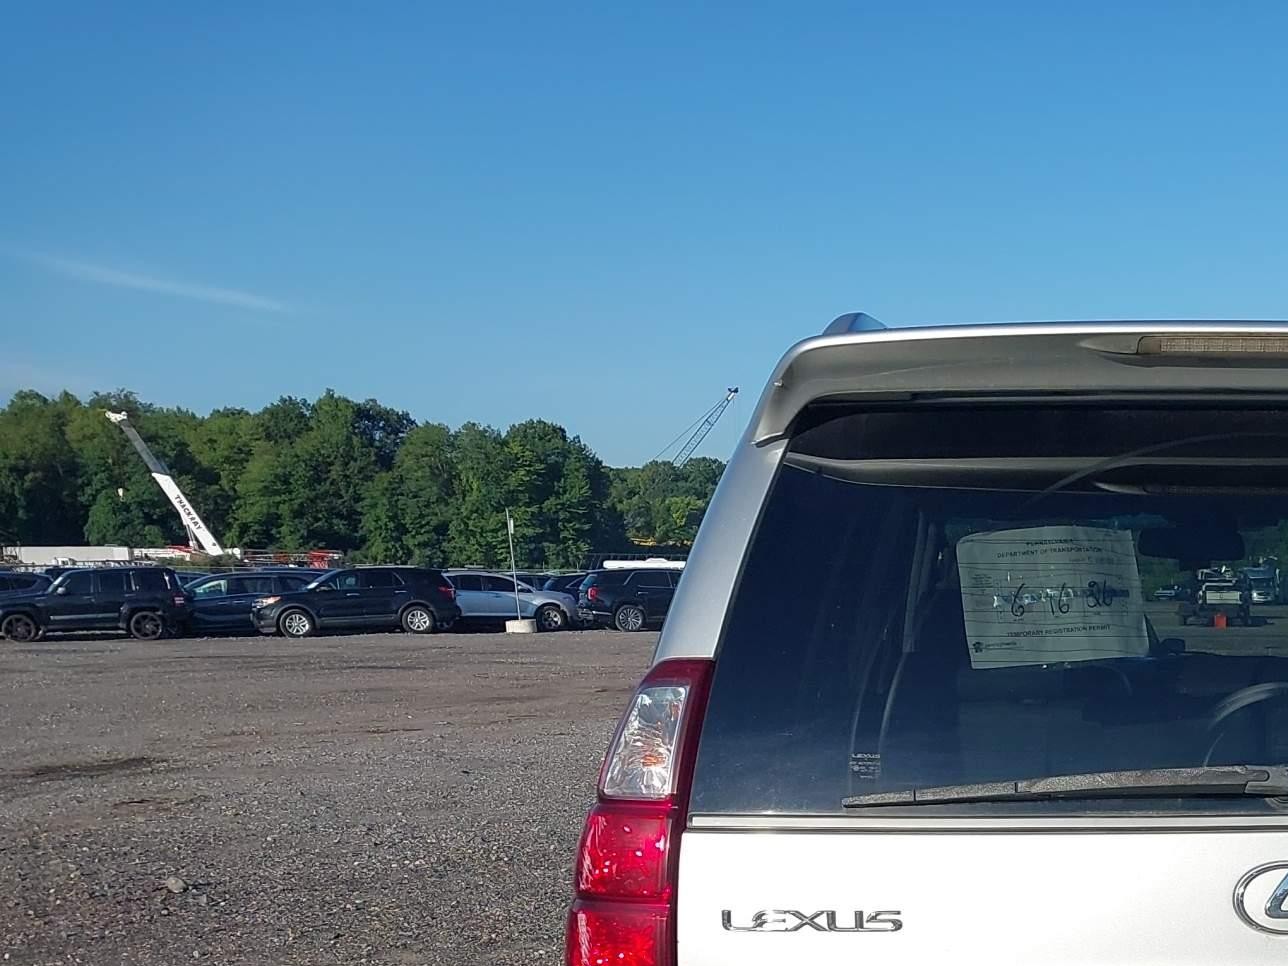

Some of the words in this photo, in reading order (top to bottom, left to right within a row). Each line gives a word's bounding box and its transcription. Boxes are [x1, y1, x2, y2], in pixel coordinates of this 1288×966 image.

[174, 494, 203, 530] THACKRAY
[997, 549, 1038, 558] DEPARTMENT
[1010, 583, 1026, 617] 6
[1088, 623, 1112, 632] PERMIT
[720, 909, 904, 933] LEXUS
